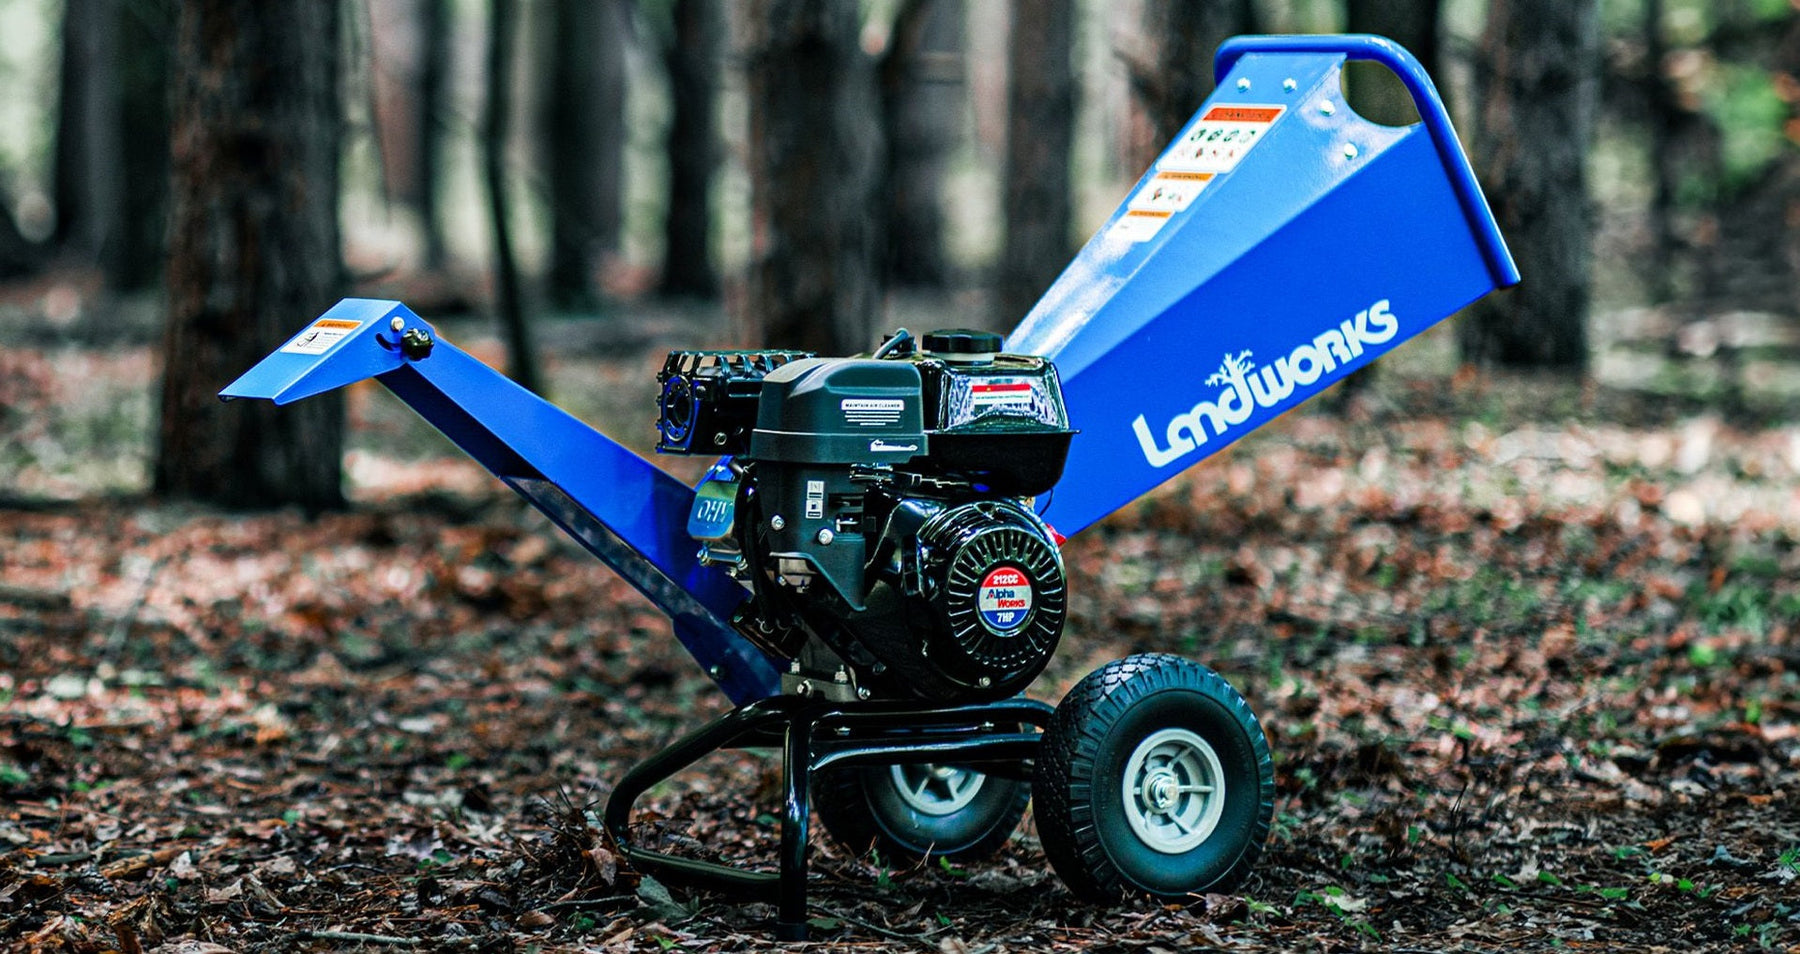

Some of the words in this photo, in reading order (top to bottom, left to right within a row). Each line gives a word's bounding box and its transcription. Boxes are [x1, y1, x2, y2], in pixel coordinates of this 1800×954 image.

[993, 575, 1018, 585] 212CC
[986, 588, 1014, 600] Alpha
[997, 612, 1014, 622] 7HP
